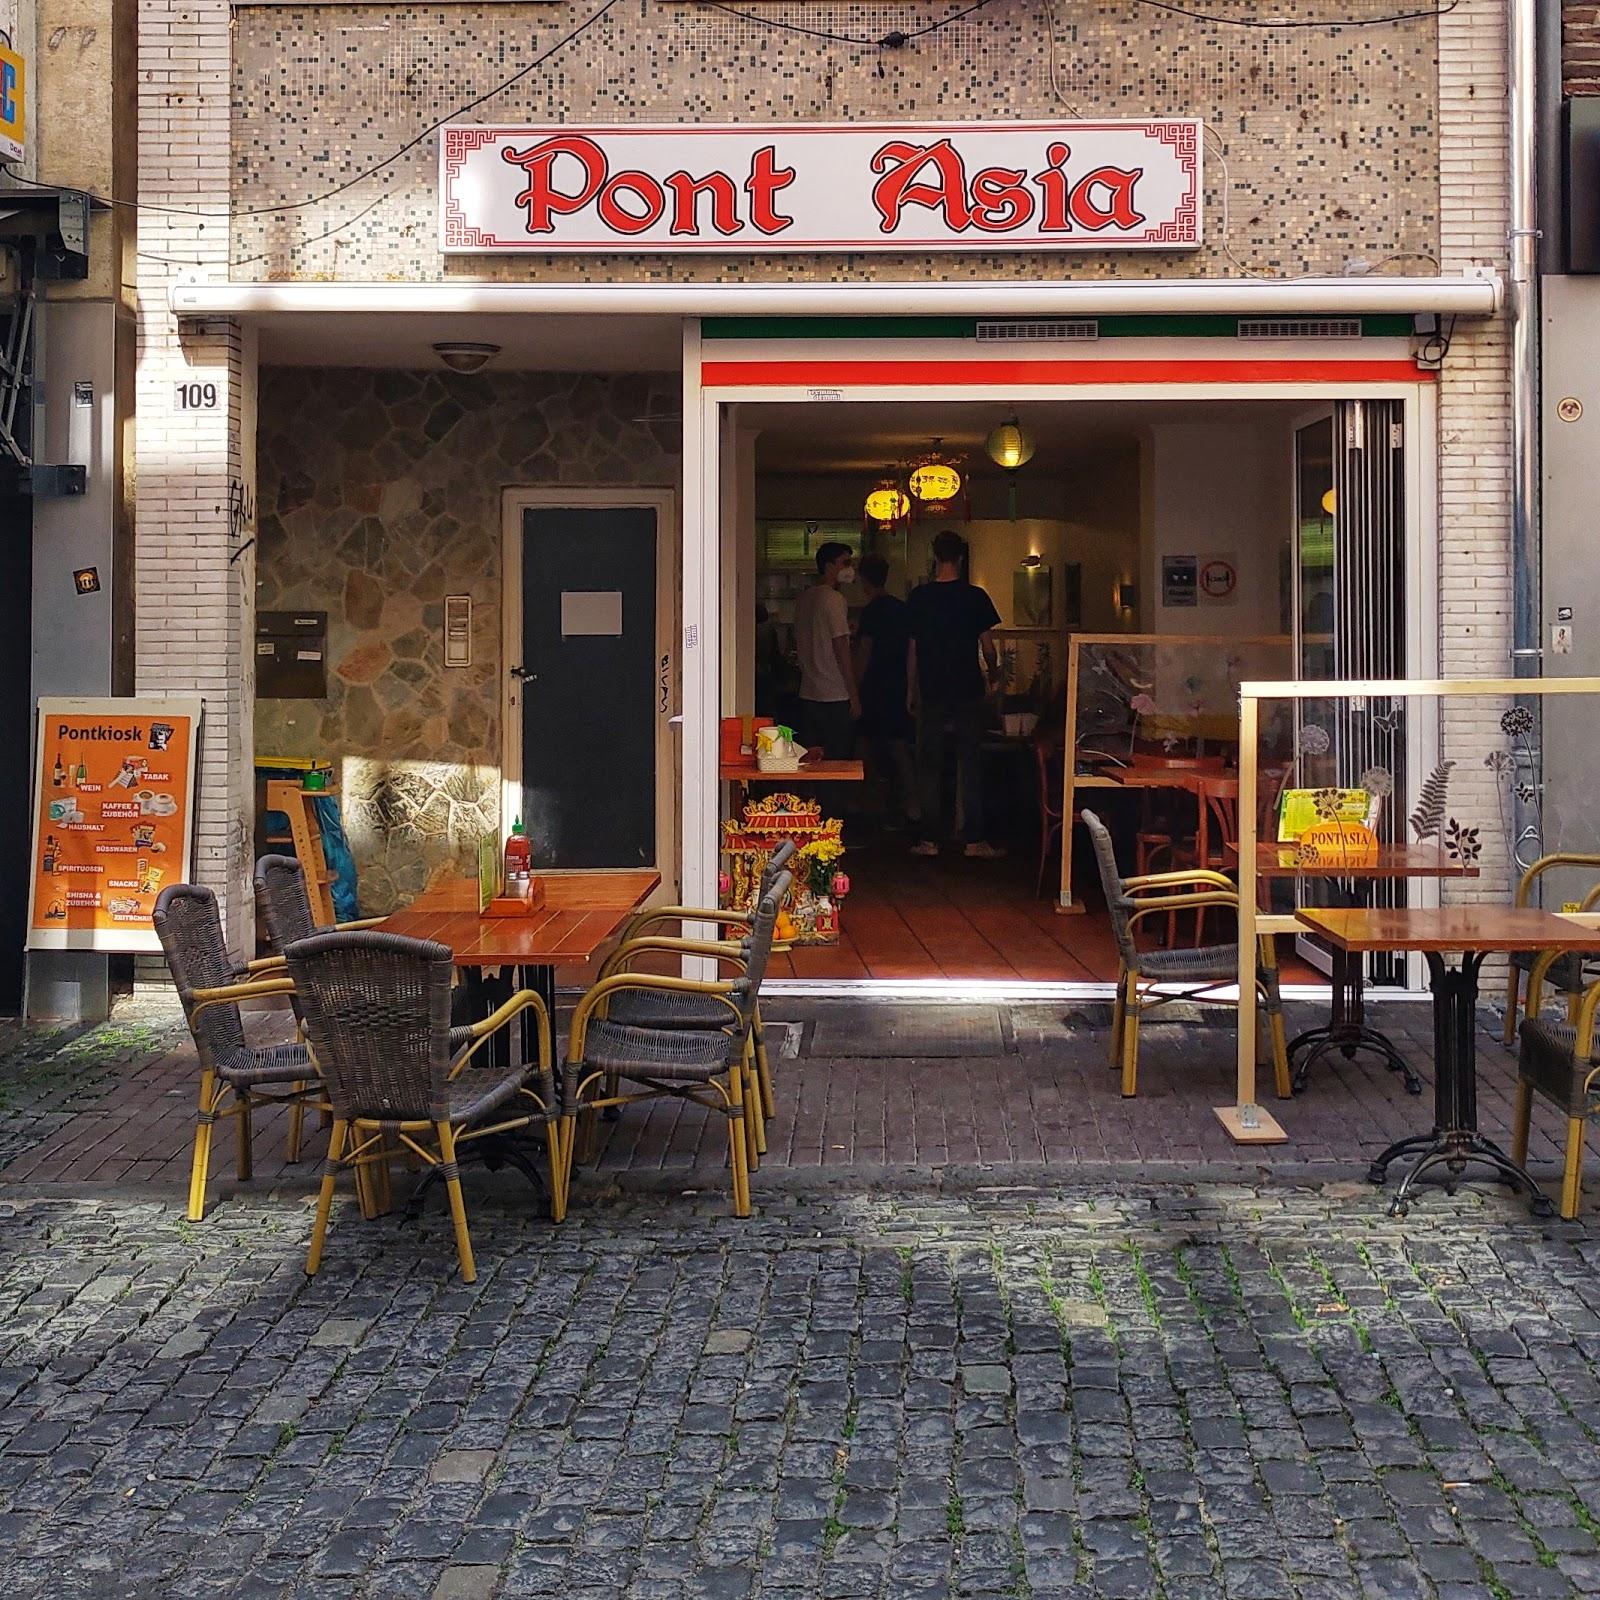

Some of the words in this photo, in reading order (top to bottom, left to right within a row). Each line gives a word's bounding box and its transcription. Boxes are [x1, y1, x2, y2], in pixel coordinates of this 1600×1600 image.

[501, 135, 796, 235] Pont
[870, 138, 1146, 233] Asia
[177, 383, 217, 409] 109
[58, 724, 143, 742] Pontkiosk
[143, 773, 169, 781] TABAK
[80, 784, 102, 792] WEIN
[102, 802, 132, 810] KAFFEE
[1311, 832, 1368, 845] PONTASIA
[58, 865, 104, 873] SPIRITUOSEN
[108, 879, 139, 888] SNACKS
[66, 891, 94, 899] SHISHA
